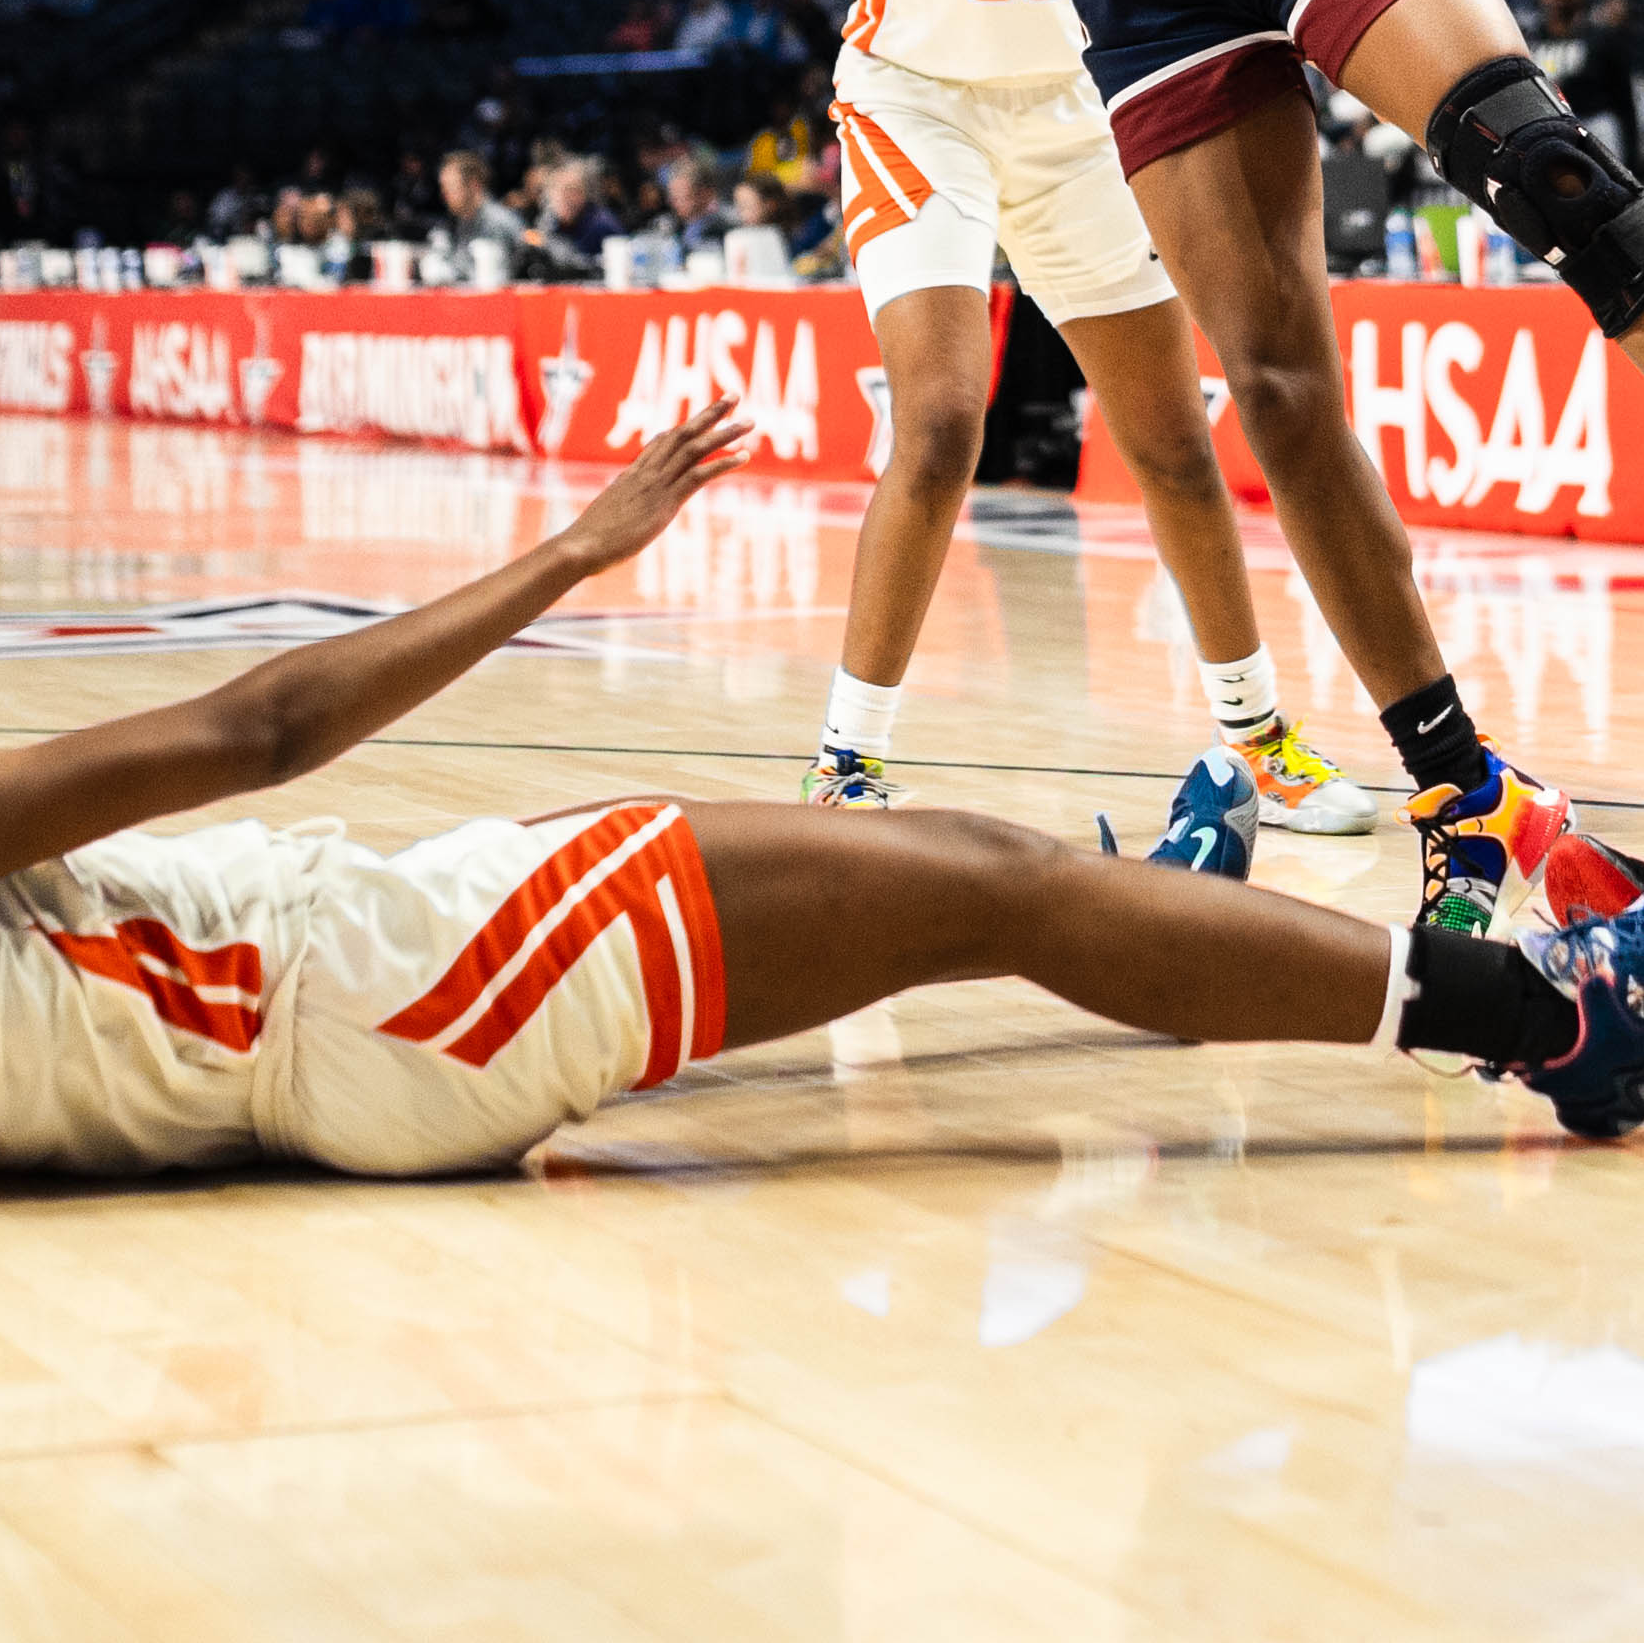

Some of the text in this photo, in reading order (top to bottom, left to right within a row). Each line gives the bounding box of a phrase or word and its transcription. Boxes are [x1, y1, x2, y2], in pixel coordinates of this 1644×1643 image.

[130, 322, 233, 420] AHSAA
[604, 310, 820, 461] AHSAA
[1350, 319, 1613, 517] HSAA
